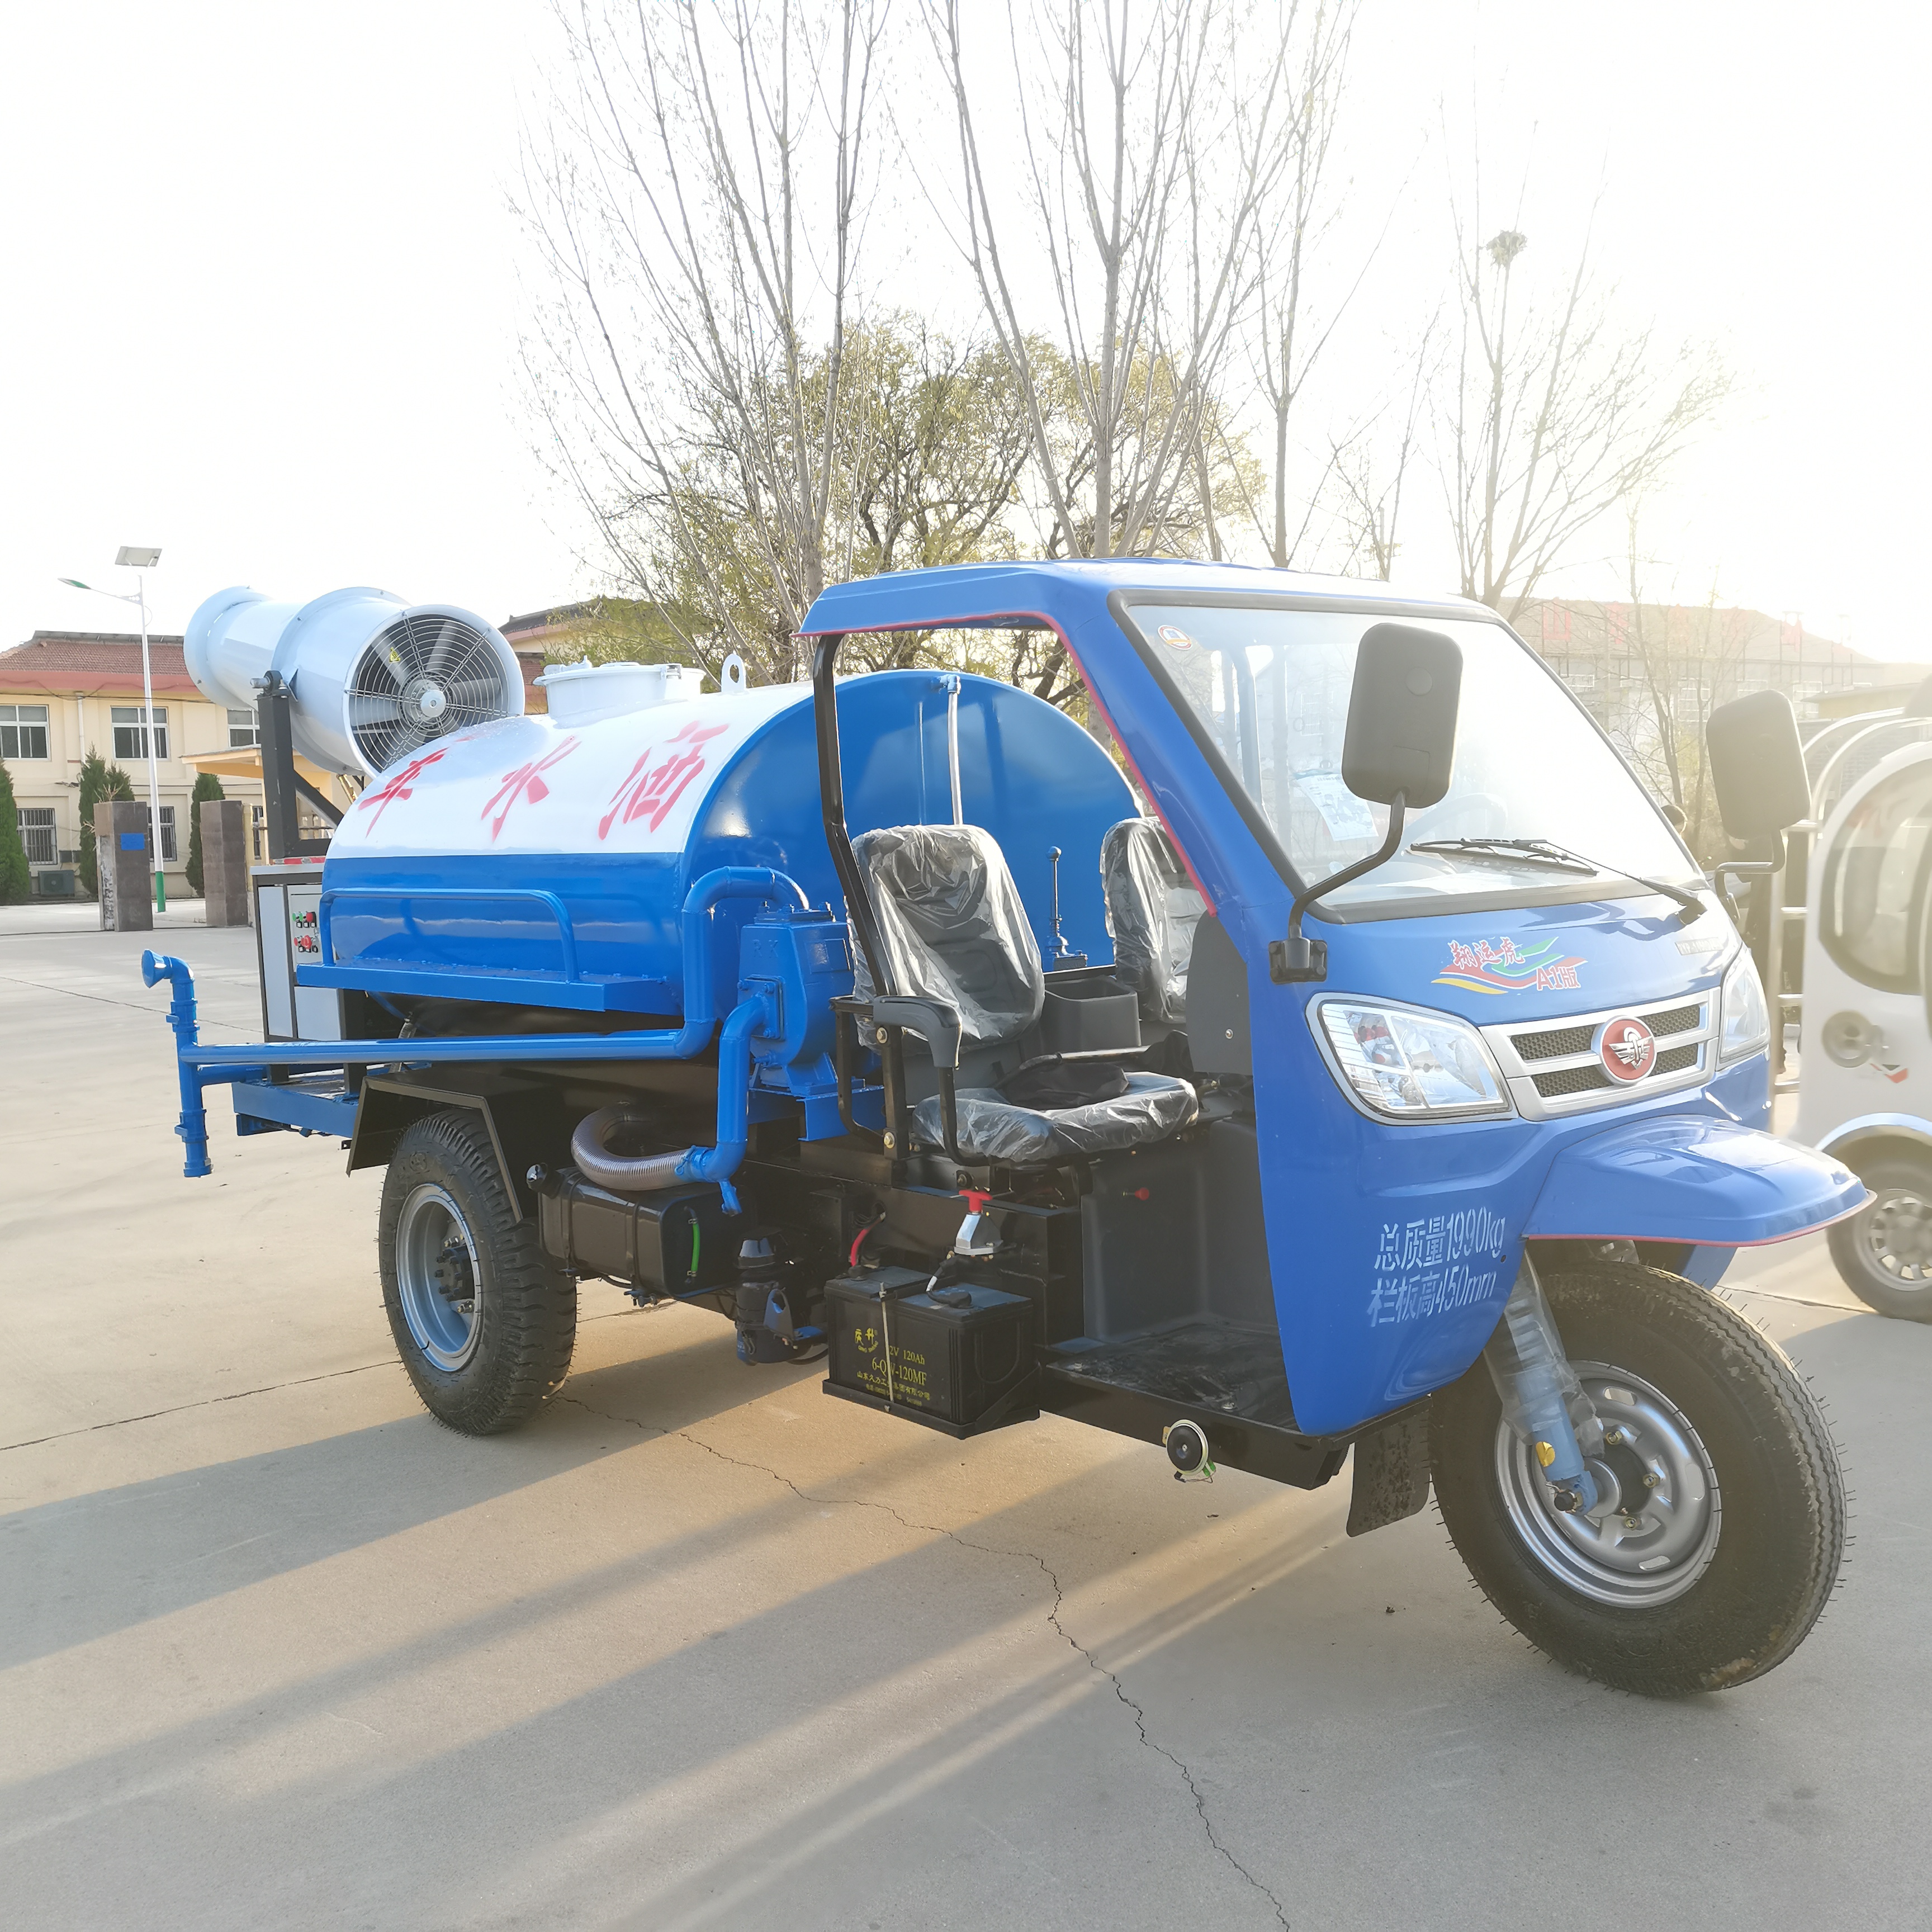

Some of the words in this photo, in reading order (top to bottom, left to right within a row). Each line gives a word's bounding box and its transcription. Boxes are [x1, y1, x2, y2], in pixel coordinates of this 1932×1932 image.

[1374, 1206, 1505, 1271] 总质量1990kg
[1367, 1263, 1497, 1327] 栏板高450mm
[888, 1345, 899, 1357] 2V
[903, 1349, 925, 1365] 120Ah
